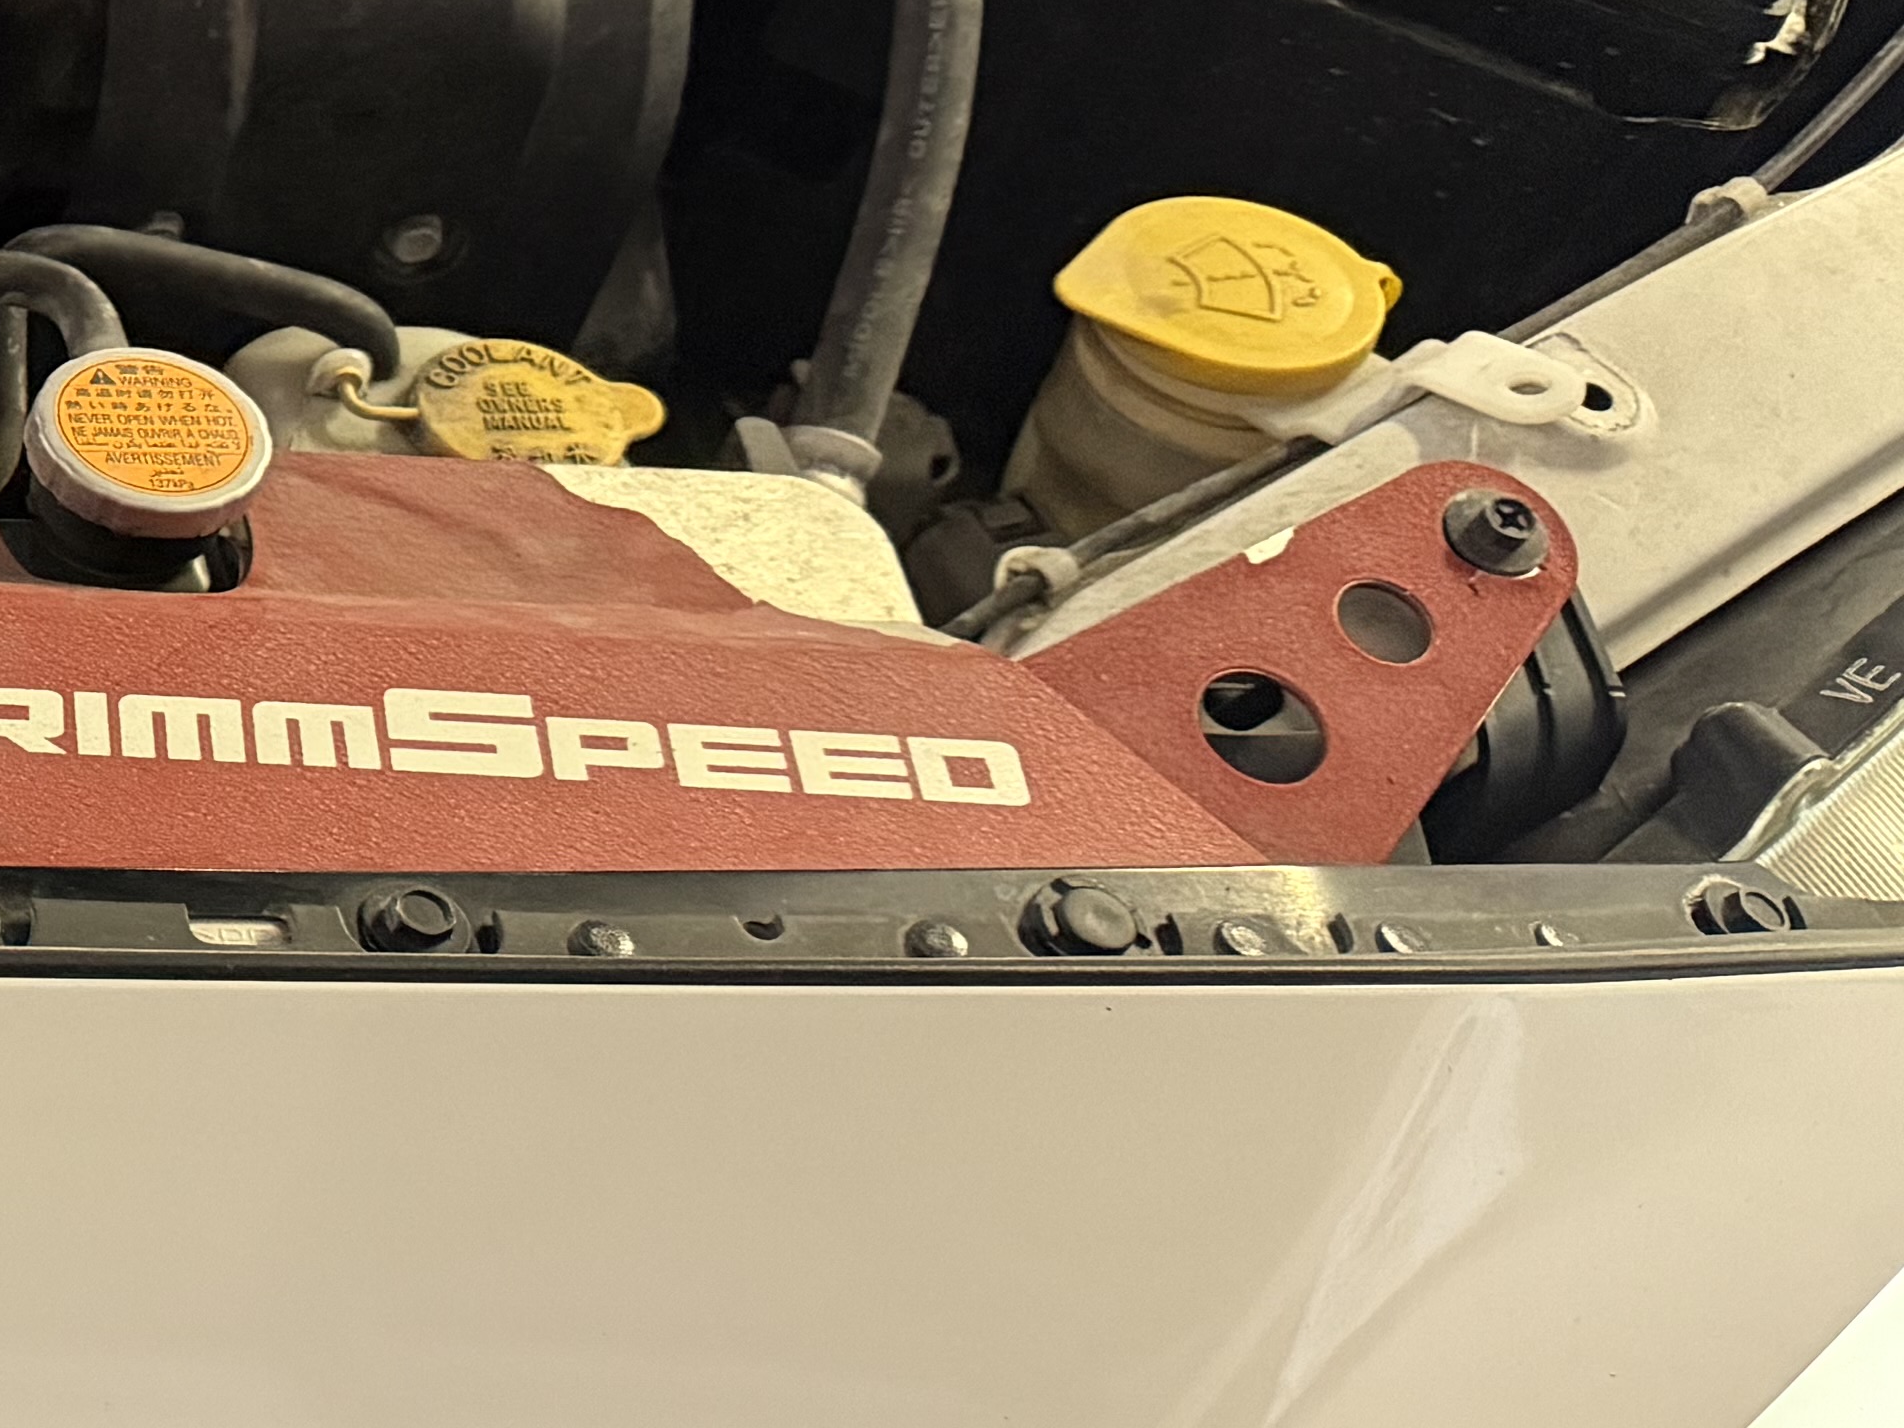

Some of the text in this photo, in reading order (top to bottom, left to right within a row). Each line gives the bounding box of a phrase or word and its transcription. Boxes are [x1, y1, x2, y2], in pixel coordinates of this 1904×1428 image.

[424, 343, 592, 390] COOLANT
[117, 376, 192, 388] WARNING
[482, 380, 532, 398] SEE
[67, 413, 113, 423] NEVER
[116, 414, 155, 425] OPEN
[157, 415, 202, 426] WHEN
[482, 414, 574, 431] MANUAL
[70, 426, 88, 437] NE
[91, 426, 133, 437] JAMAIS
[136, 428, 180, 439] OUVRIR
[104, 452, 221, 466] AVERTISSEMENT
[1819, 657, 1903, 704] VE
